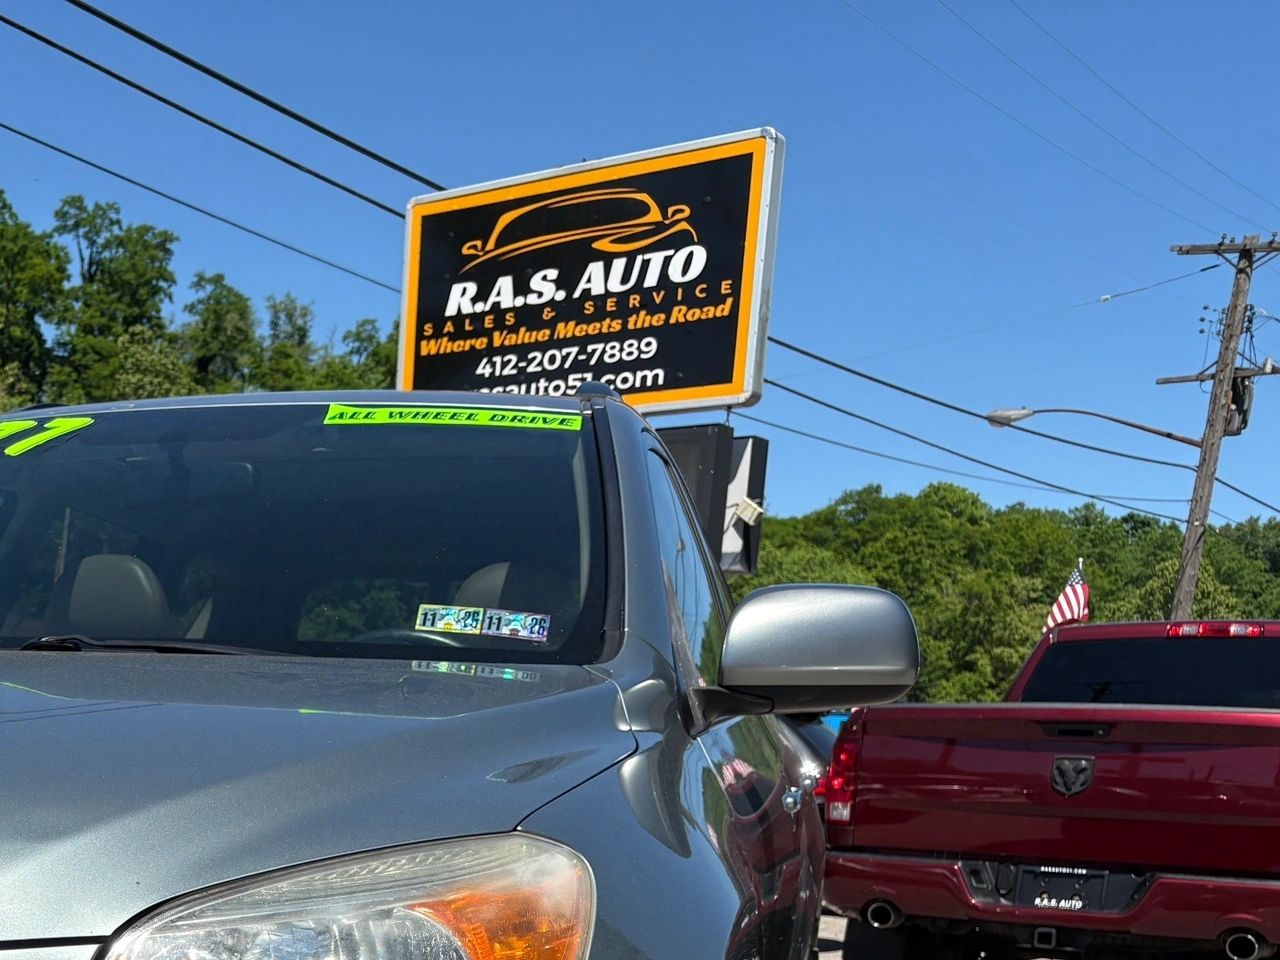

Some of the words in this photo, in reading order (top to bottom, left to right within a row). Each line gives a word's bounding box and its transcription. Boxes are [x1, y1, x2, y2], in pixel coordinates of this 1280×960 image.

[444, 268, 567, 317] R.A.S.
[572, 244, 708, 299] AUTO
[420, 335, 489, 357] Where
[492, 325, 552, 348] Value
[554, 316, 623, 340] Meets
[626, 309, 667, 331] the
[669, 297, 734, 325] Road
[423, 312, 517, 337] SALES
[542, 306, 557, 321] &
[583, 279, 734, 315] SERVICE
[475, 336, 658, 379] 412-207-7889
[327, 410, 377, 421] ALL
[387, 410, 481, 423] WHEEL
[488, 413, 577, 427] DRIVE
[1058, 899, 1083, 909] AUTO
